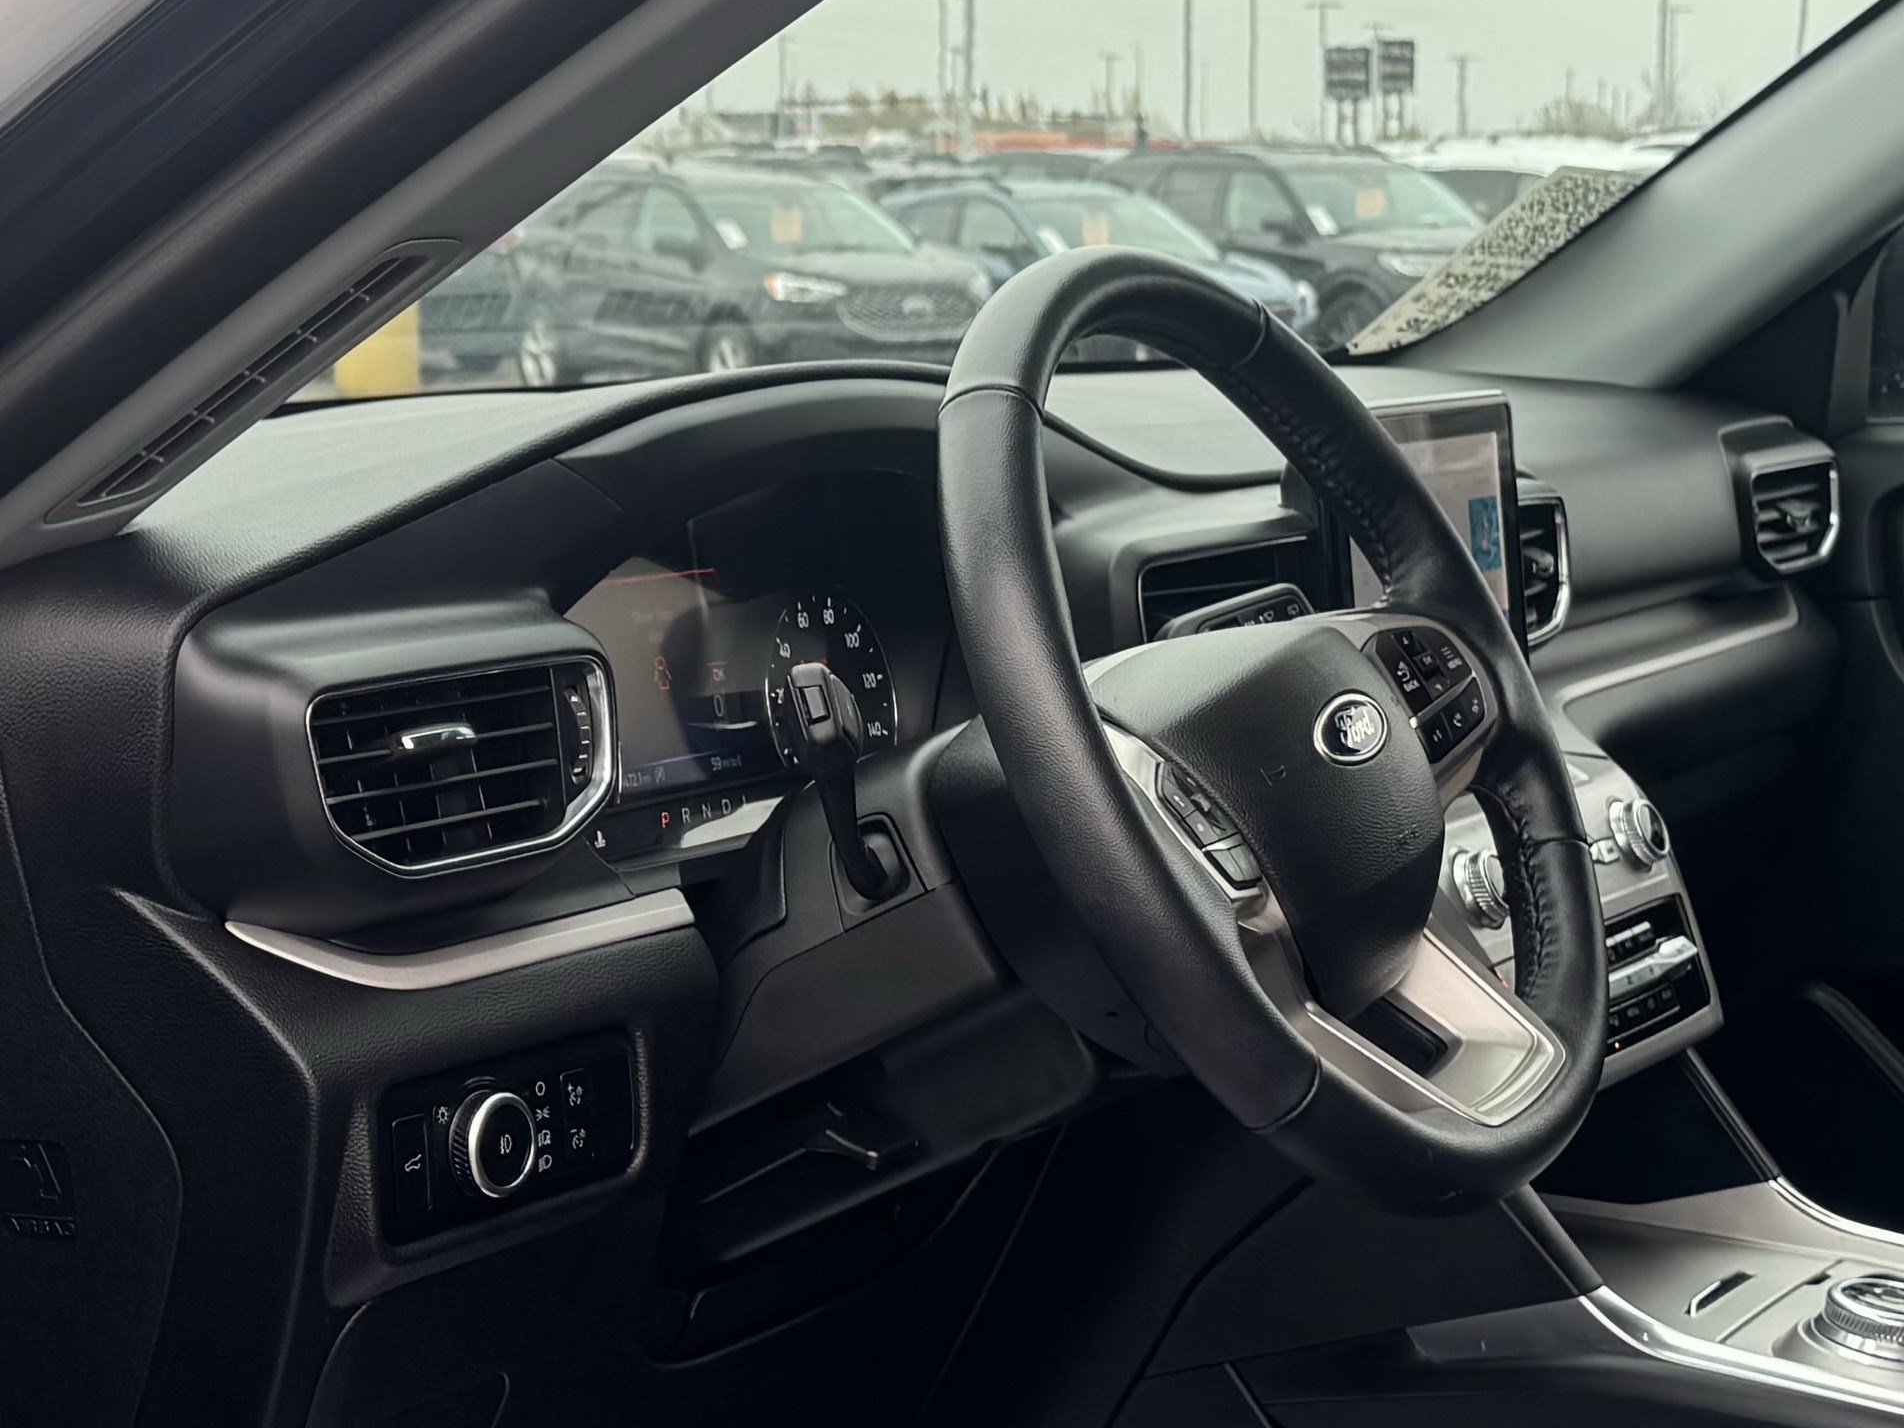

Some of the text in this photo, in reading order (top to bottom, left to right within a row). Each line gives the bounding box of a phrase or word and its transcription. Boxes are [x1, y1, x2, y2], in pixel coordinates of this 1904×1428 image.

[823, 608, 835, 625] 80
[1334, 703, 1376, 747] Ford
[661, 811, 670, 828] P
[681, 807, 691, 824] R
[701, 802, 712, 819] N
[721, 798, 732, 815] D
